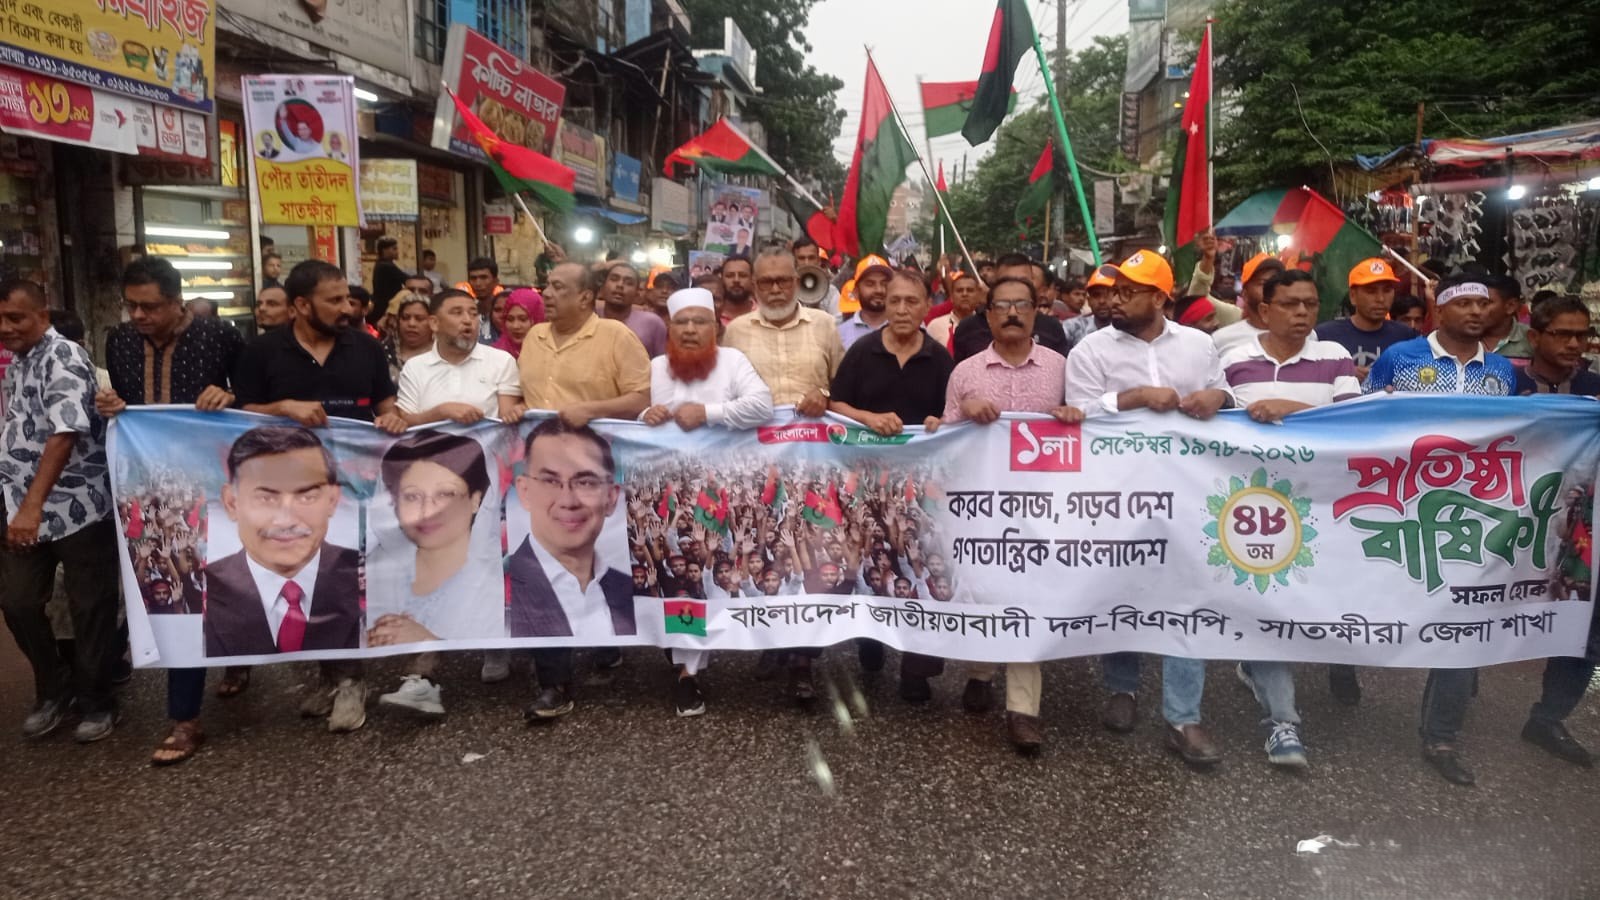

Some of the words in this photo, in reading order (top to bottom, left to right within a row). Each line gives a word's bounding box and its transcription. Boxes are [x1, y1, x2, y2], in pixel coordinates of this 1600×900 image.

[262, 167, 292, 191] পৌর
[297, 163, 349, 192] তাঁতীদল
[280, 196, 337, 223] সাতক্ষীরা
[773, 426, 818, 441] বাংলাদেশ
[1015, 421, 1079, 465] ১লা
[1090, 430, 1173, 456] সেপ্টেম্বর
[1178, 437, 1316, 464] ১৯৭৮-২০২৬
[1332, 434, 1526, 520] প্রতিষ্ঠা
[946, 490, 995, 520] করব
[998, 491, 1060, 524] কাজ,
[1066, 491, 1122, 526] গড়ব
[1127, 491, 1174, 520] দেশ
[1232, 504, 1287, 537] ৪৮
[1349, 471, 1564, 594] বার্ষিকী
[952, 527, 1050, 574] গণতান্ত্রিক
[1055, 538, 1168, 568] বাংলাদেশ
[1246, 542, 1275, 561] তম
[1449, 583, 1506, 606] সফল
[1508, 579, 1551, 602] হোক
[727, 601, 859, 629] বাংলাদেশ
[866, 600, 1036, 638] জাতীয়তাবাদী
[1257, 613, 1409, 644] সাতক্ষীরা
[1418, 617, 1494, 643] জেলা
[1500, 609, 1558, 638] শাখা
